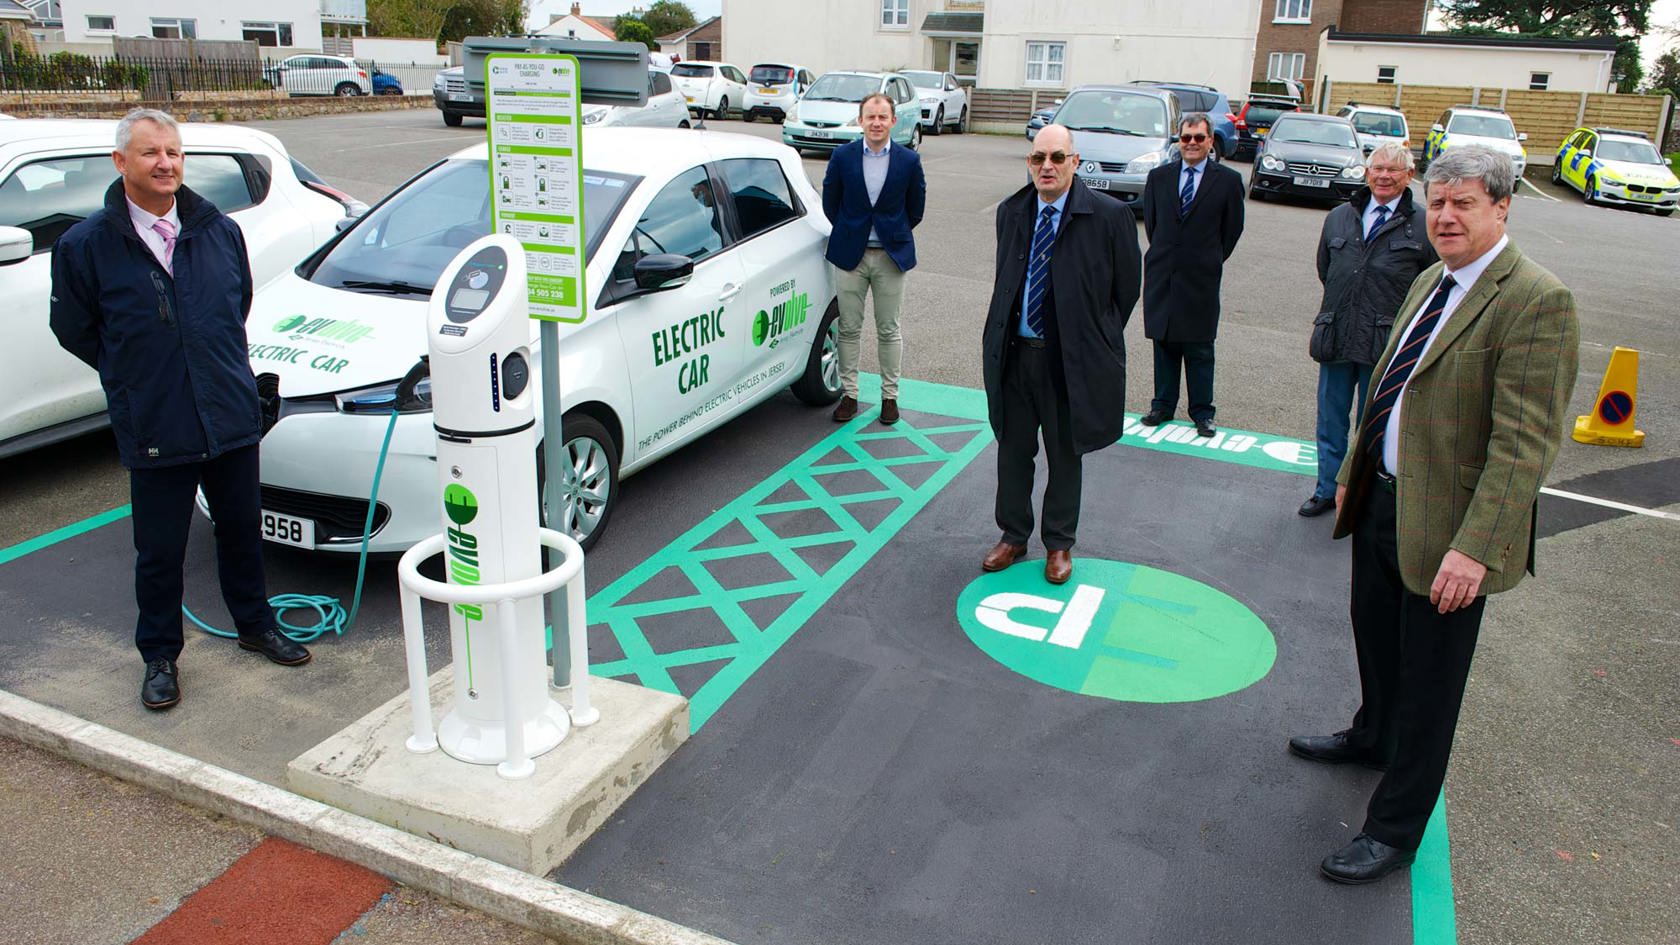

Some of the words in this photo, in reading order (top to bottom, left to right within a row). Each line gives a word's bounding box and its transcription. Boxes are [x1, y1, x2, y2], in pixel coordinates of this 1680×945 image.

[770, 282, 789, 298] POWERED
[790, 278, 796, 290] BY
[770, 290, 809, 338] evolve
[652, 306, 726, 367] ELECTRIC
[247, 343, 309, 364] LECTRIC
[310, 355, 349, 374] CAR
[678, 353, 710, 395] CAR
[638, 437, 652, 451] THE
[652, 419, 677, 444] POWER
[678, 405, 703, 429] BEHIND
[704, 389, 732, 413] ELECTRIC
[732, 374, 760, 396] VEHICLES
[761, 369, 768, 381] IN
[768, 361, 786, 378] JERSEY
[264, 514, 302, 543] 958
